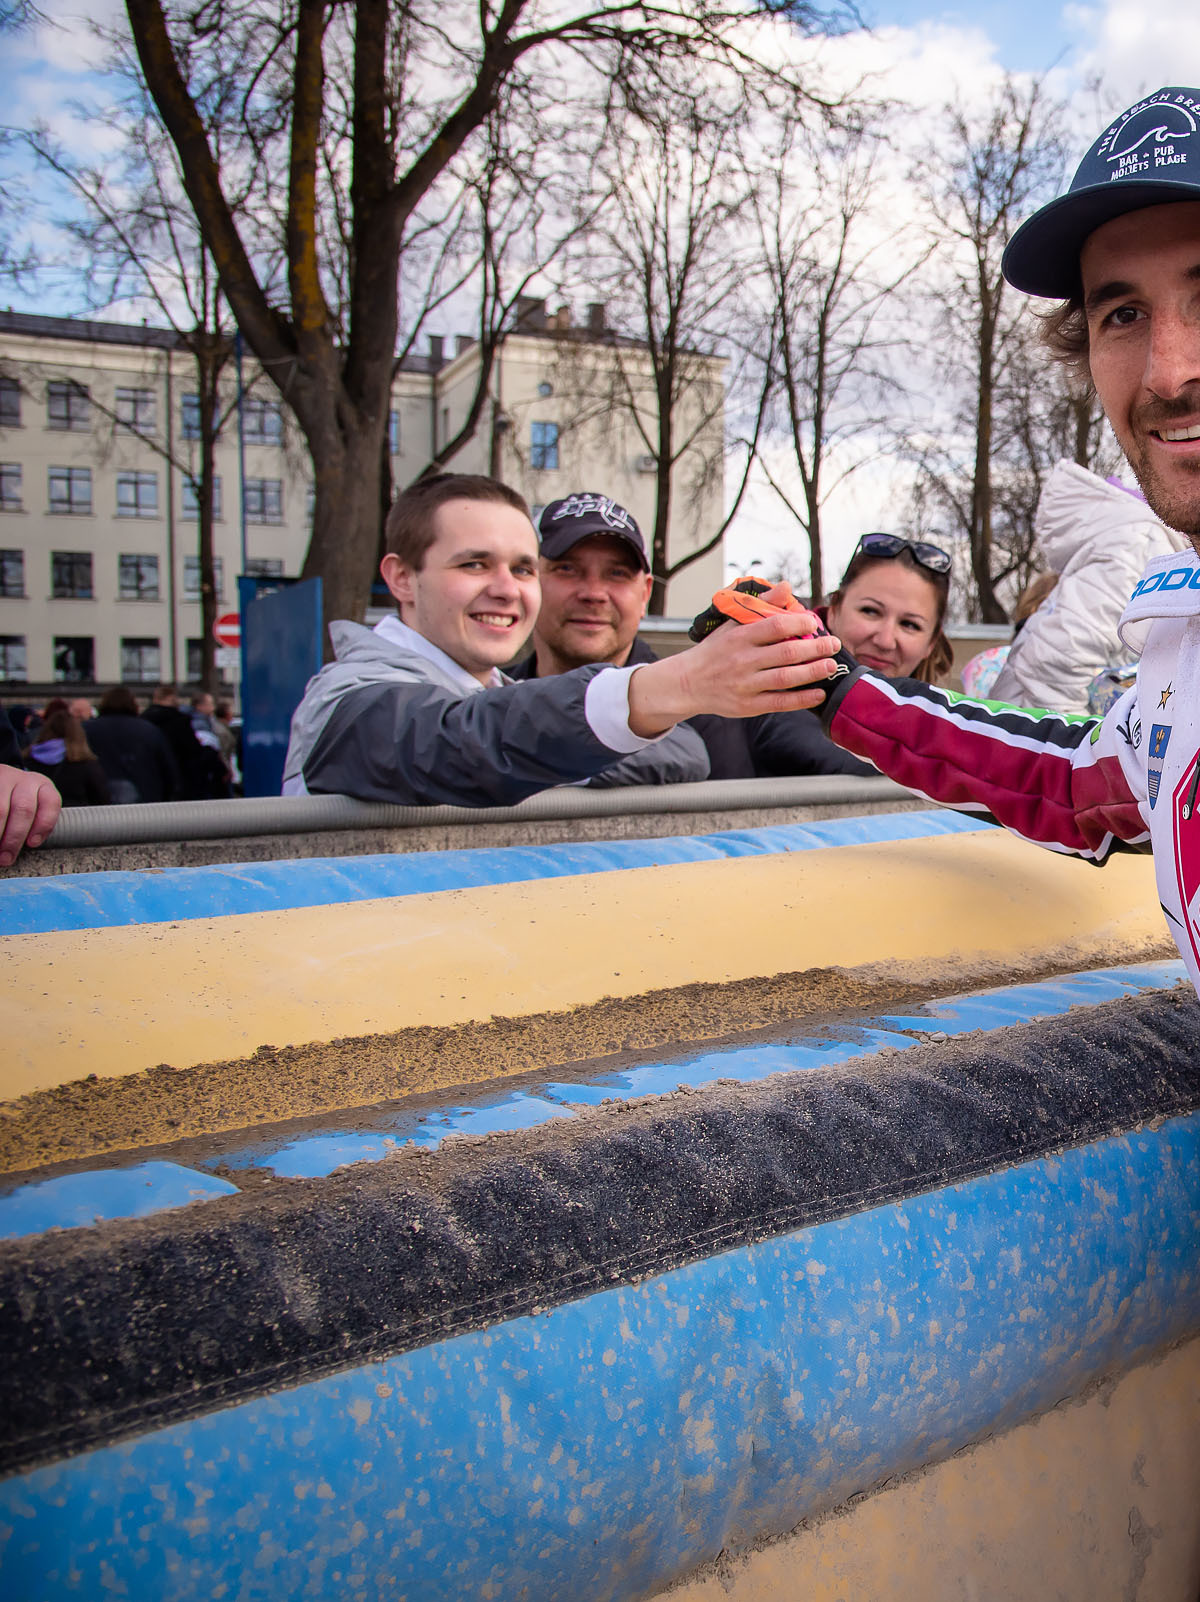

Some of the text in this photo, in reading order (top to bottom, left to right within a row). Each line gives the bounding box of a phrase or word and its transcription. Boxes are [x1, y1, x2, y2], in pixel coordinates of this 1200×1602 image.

[1119, 153, 1138, 168] BAR
[1154, 145, 1175, 157] PUB
[1155, 153, 1187, 167] PLAGE
